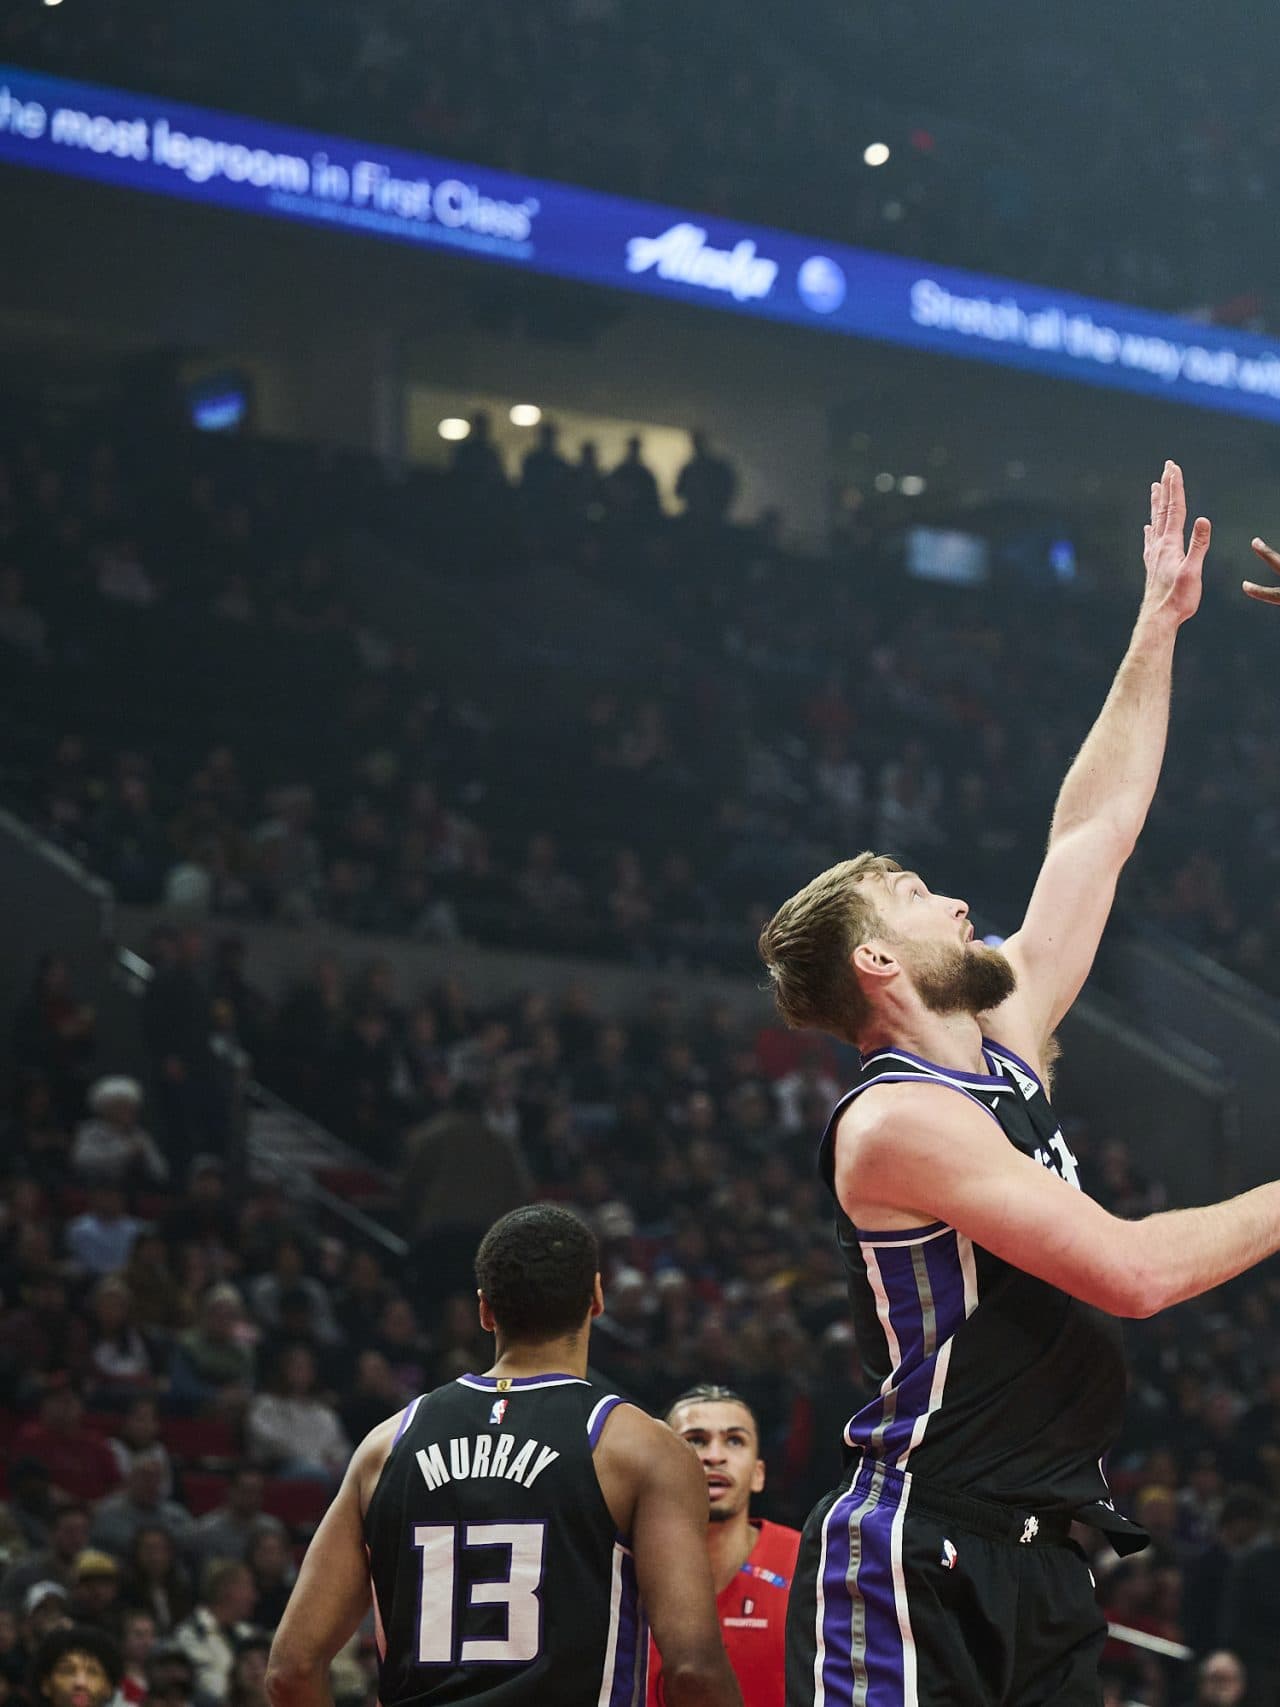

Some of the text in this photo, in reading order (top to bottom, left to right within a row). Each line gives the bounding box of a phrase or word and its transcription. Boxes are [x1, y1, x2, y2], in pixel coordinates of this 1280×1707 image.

[0, 86, 47, 139] he
[52, 108, 149, 162] most
[153, 118, 310, 194] legroom
[312, 151, 349, 202] in
[352, 160, 432, 222] First
[911, 279, 1027, 345] Stretch
[1027, 306, 1065, 350] all
[1064, 312, 1121, 364] the
[1120, 332, 1180, 384] way
[415, 1433, 560, 1491] MURRAY
[411, 1519, 547, 1665] 13
